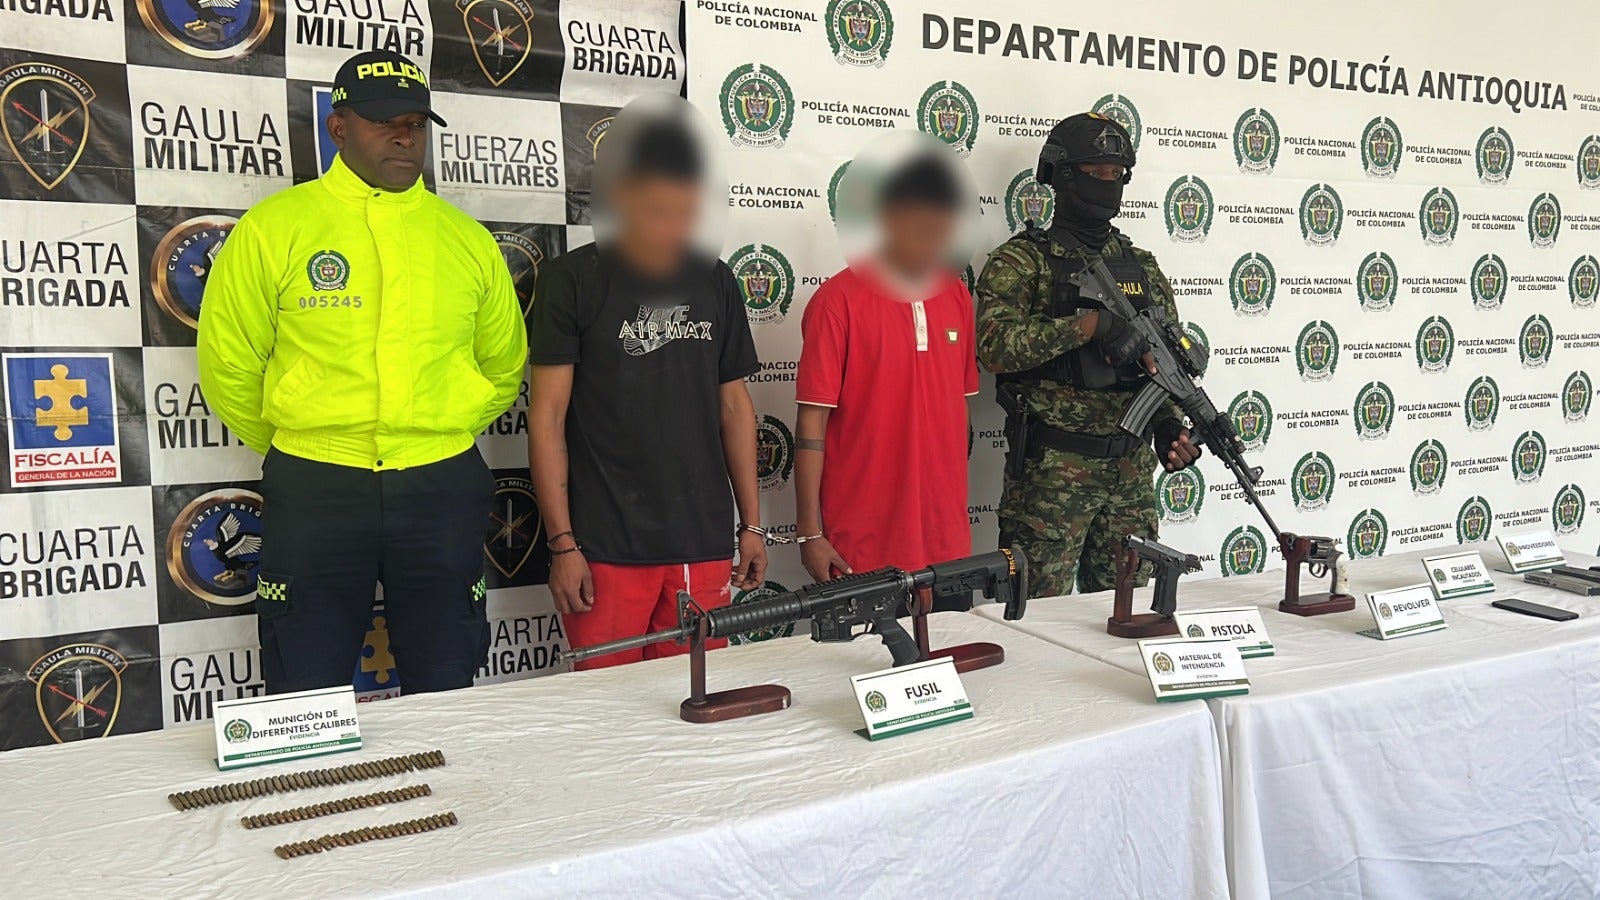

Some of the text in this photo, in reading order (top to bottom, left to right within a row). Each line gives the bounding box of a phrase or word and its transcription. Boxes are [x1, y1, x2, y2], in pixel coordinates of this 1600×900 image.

[698, 0, 817, 21] POLICÍA NACIONAL
[715, 15, 801, 32] DE COLOMBIA
[296, 15, 424, 56] MILITAR
[568, 20, 676, 55] CUARTA
[573, 47, 677, 80] BRIGADA
[922, 13, 1567, 113] DEPARTAMENTO DE POLICÍA ANTIOQUIA
[0, 66, 88, 94] GAULA MILITAR
[802, 101, 910, 117] POLICÍA NACIONAL
[141, 102, 281, 146] GAULA
[818, 115, 895, 128] DE COLOMBIA
[1147, 127, 1228, 139] POLICÍA NACIONAL
[1173, 140, 1216, 149] COLOMBIA
[1284, 136, 1356, 148] POLICÍA NACIONAL
[440, 133, 558, 165] FUERZAS
[1307, 148, 1345, 157] COLOMBIA
[1434, 148, 1471, 156] NACIONAL
[144, 138, 284, 176] MILITAR
[1426, 156, 1462, 164] COLOMBIA
[1542, 153, 1574, 161] NACIONAL
[442, 161, 559, 188] MILITARES
[1219, 205, 1252, 213] POLICÍA
[1347, 209, 1376, 217] POLICÍA
[1243, 216, 1283, 224] COLOMBIA
[168, 231, 208, 271] CUARTA
[503, 234, 538, 257] MILITAR
[2, 240, 128, 275] UARTA
[1402, 276, 1430, 284] POLICÍA
[2, 277, 130, 308] RIGADA
[299, 296, 362, 308] 005245
[619, 320, 712, 340] AIR MAX
[1215, 346, 1291, 355] POLICÍA NACIONAL
[1344, 342, 1373, 350] POLICÍA
[1238, 356, 1279, 364] COLOMBIA
[1277, 410, 1308, 420] POLICÍA
[1418, 411, 1451, 419] COLOMBIA
[1300, 419, 1338, 427] COLOMBIA
[158, 419, 245, 449] MILI
[15, 448, 115, 467] FISCALÍA
[1451, 456, 1508, 467] POLICÍA NACIONAL
[18, 473, 56, 481] GENERAL
[82, 469, 114, 477] NACIÓN
[1339, 467, 1405, 479] POLICÍA NACIONAL
[1468, 465, 1499, 474] COLOMBIA
[1360, 477, 1396, 486] COLOMBIA
[1495, 508, 1549, 520] POLICÍA NACIONAL
[184, 503, 261, 547] CUARTA BRIG
[1512, 516, 1541, 526] COLOMBIA
[1392, 523, 1452, 536] POLICÍA NACIONAL
[1411, 532, 1443, 542] COLOMBIA
[0, 525, 144, 566] CUARTA
[0, 561, 146, 599] BRIGADA
[1393, 599, 1430, 612] REVOLVER
[489, 614, 563, 648] ARTA
[1211, 623, 1255, 636] PISTOLA
[35, 647, 122, 675] GAULA MILITAR
[476, 644, 562, 678] RIGADA
[170, 651, 263, 692] GAU
[905, 682, 941, 699] FUSIL
[269, 711, 322, 726] MUNICIÓN
[252, 718, 356, 738] DIFERENTES CALIBRES
